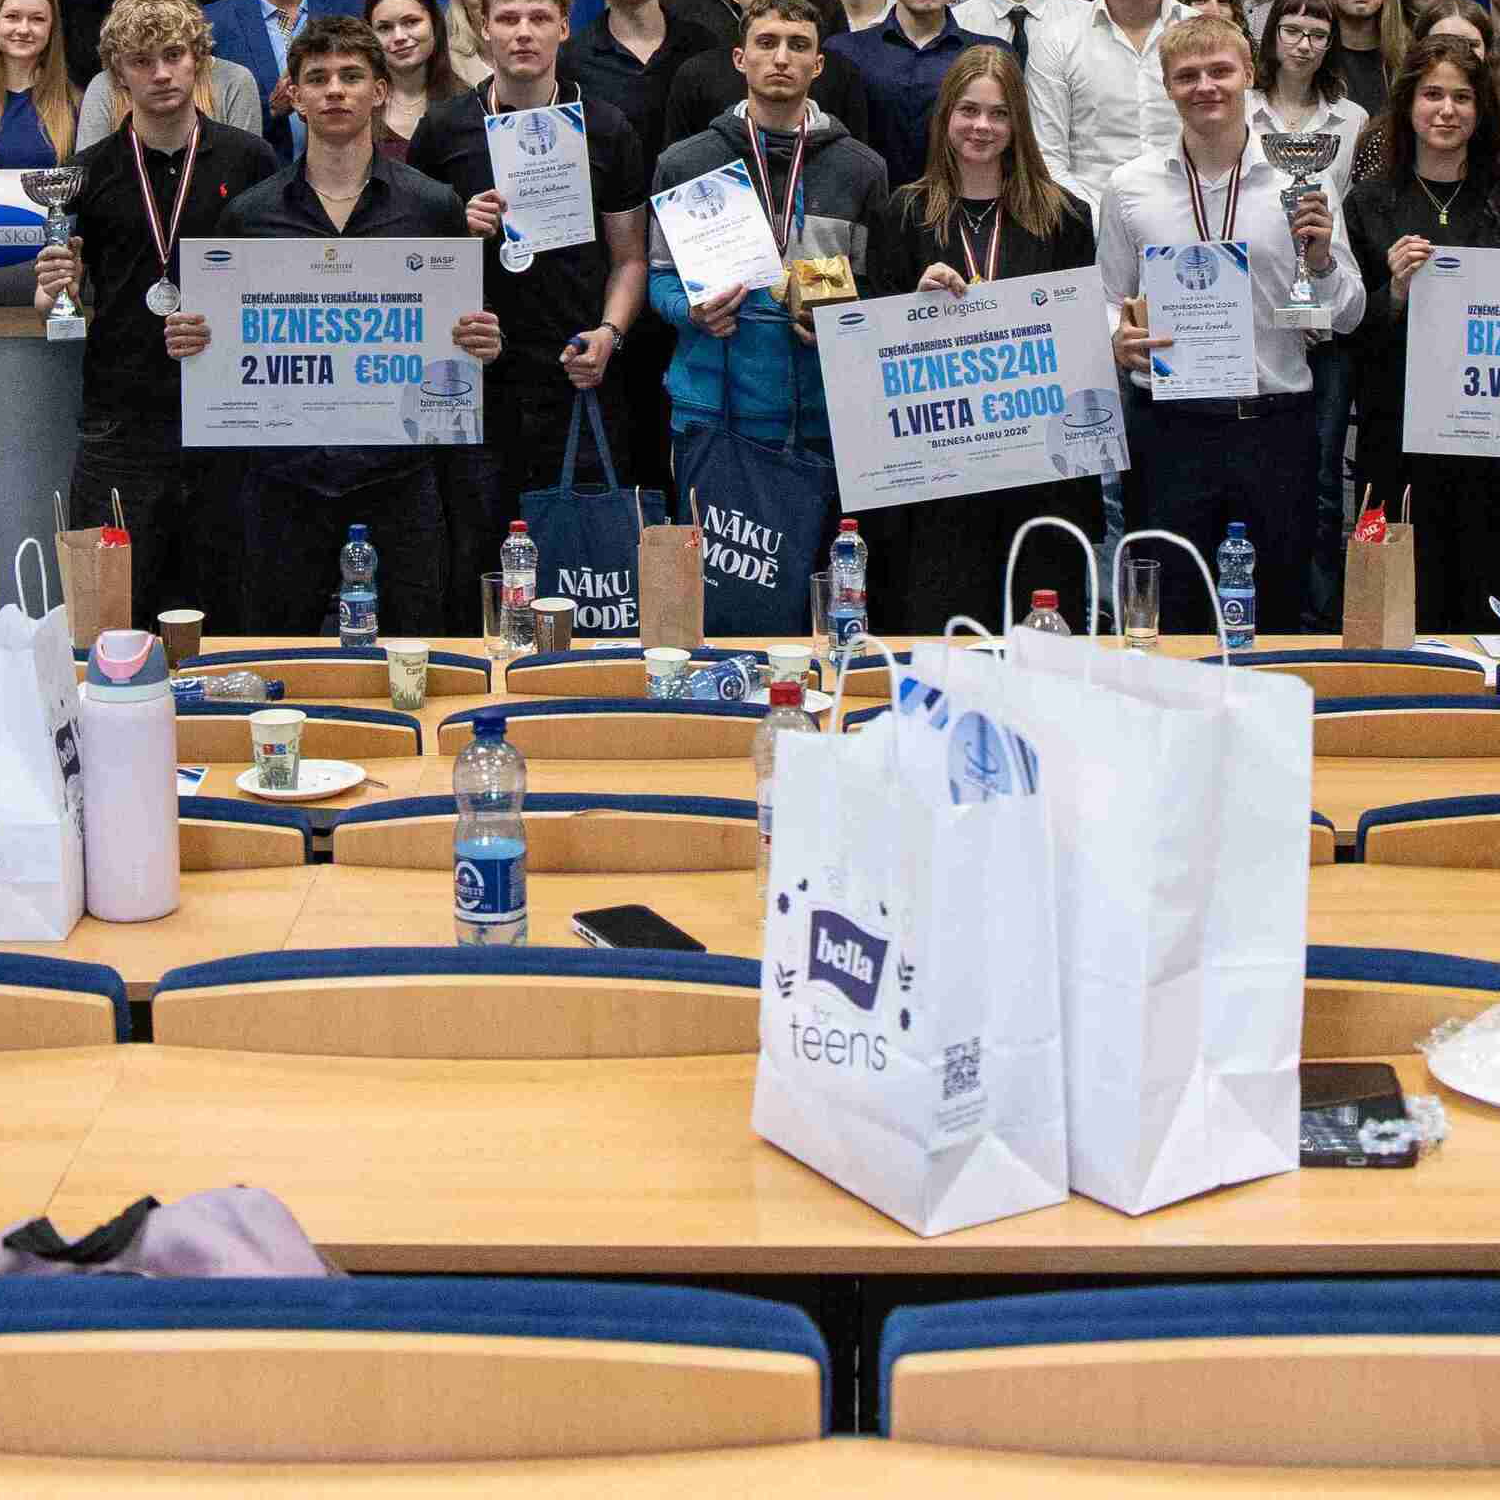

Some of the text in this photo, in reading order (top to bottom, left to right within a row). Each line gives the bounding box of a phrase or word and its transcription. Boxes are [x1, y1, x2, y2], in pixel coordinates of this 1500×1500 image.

[241, 308, 423, 343] BIZNESS24H
[907, 298, 998, 322] ace logistics
[241, 354, 424, 385] 2.VIETA €500
[881, 338, 1058, 398] BIZNESS24H
[888, 384, 1067, 438] 1.VIETA €3000
[703, 504, 783, 554] NĀKU
[557, 567, 631, 598] NĀKU
[702, 536, 780, 588] MODĒ
[816, 927, 875, 985] bella
[789, 1013, 888, 1071] teens
